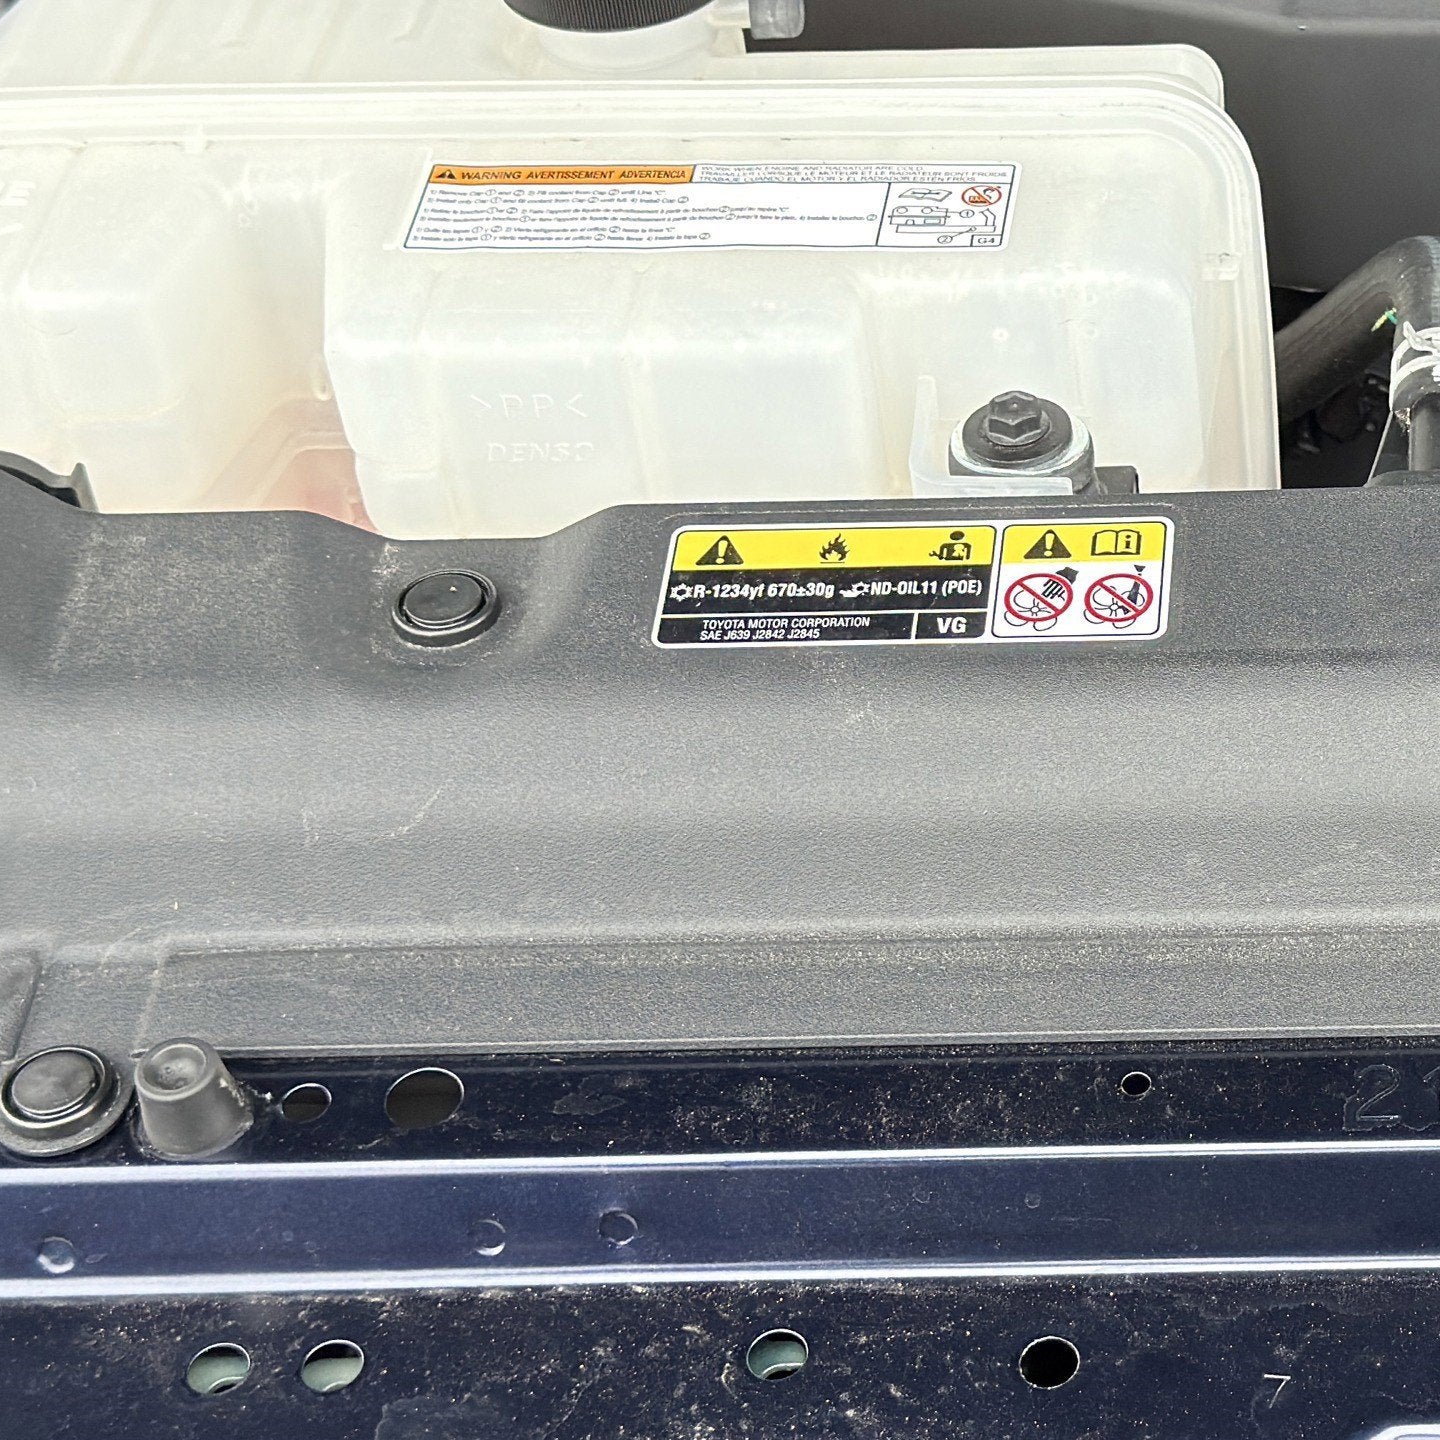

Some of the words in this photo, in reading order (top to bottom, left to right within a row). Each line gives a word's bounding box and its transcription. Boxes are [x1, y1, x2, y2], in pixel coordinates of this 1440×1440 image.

[461, 171, 522, 180] WARNING
[526, 170, 614, 180] AVERTISSEMENT
[620, 170, 686, 179] ADVERTENCIA
[977, 237, 996, 245] G4
[693, 583, 765, 599] R-1234yf
[767, 581, 834, 599] 670±30g
[870, 581, 939, 596] ND-OIL11
[942, 578, 983, 597] (POE)
[702, 619, 746, 629] TOYOTA
[748, 618, 789, 629] MOTOR
[791, 617, 870, 628] CORPORATION
[937, 617, 968, 634] VG
[700, 630, 722, 640] SAE
[724, 630, 750, 640] J639
[752, 629, 786, 640] J2842
[787, 628, 820, 639] J2845
